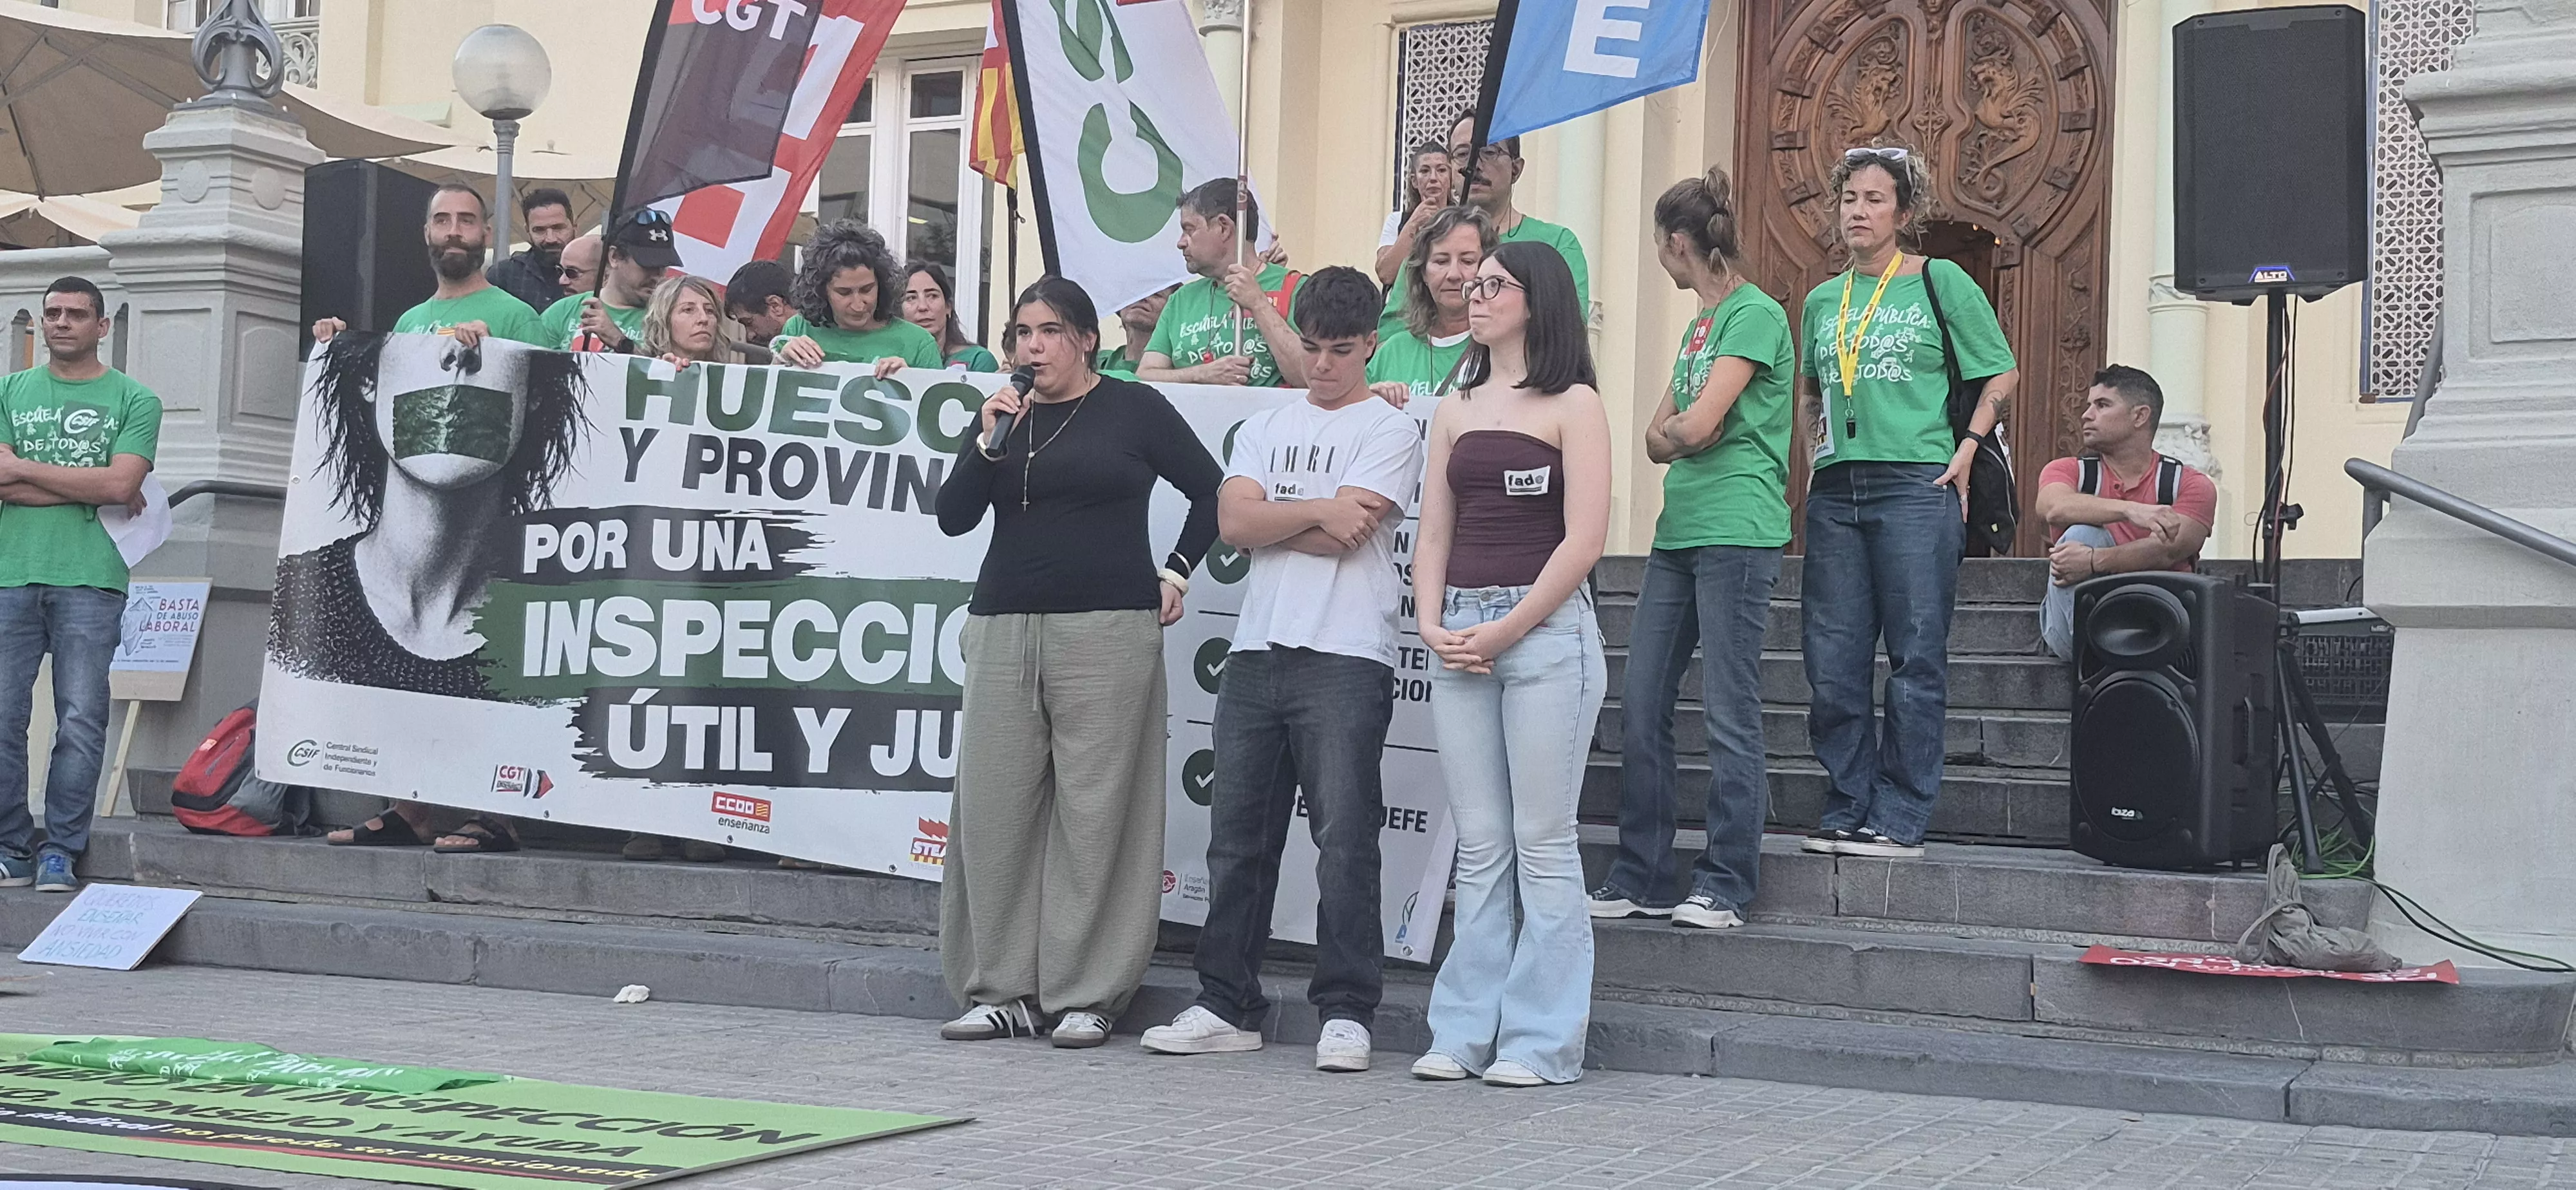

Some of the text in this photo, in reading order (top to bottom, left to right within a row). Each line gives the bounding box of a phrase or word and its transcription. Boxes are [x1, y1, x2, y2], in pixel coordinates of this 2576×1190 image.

[691, 0, 808, 40] CGT
[2255, 270, 2287, 279] ALTO
[1213, 339, 1267, 355] TO@S
[1848, 333, 1908, 353] OD@S
[23, 437, 101, 453] DE TOD@S
[620, 428, 659, 482] Y
[523, 519, 773, 573] POR UNA
[159, 598, 199, 611] BASTA
[156, 612, 199, 620] DE ABUSO
[139, 621, 196, 632] LABORAL
[607, 688, 773, 772] ÚTIL
[793, 707, 852, 773] Y
[326, 741, 379, 755] Central Sindical
[325, 753, 372, 765] Independiente
[499, 765, 524, 780] CGT
[718, 817, 770, 834] enseñanza
[37, 938, 122, 959] ANSIEDAD
[169, 1081, 311, 1097] EN
[284, 1088, 822, 1144] INSPECCIÓN
[16, 1111, 175, 1130] sindical
[160, 1128, 215, 1136] no
[205, 1133, 343, 1149] puede
[344, 1146, 418, 1155] ser
[70, 1097, 355, 1128] CONSEJO
[355, 1122, 426, 1133] Y
[395, 1129, 643, 1157] AYUDA
